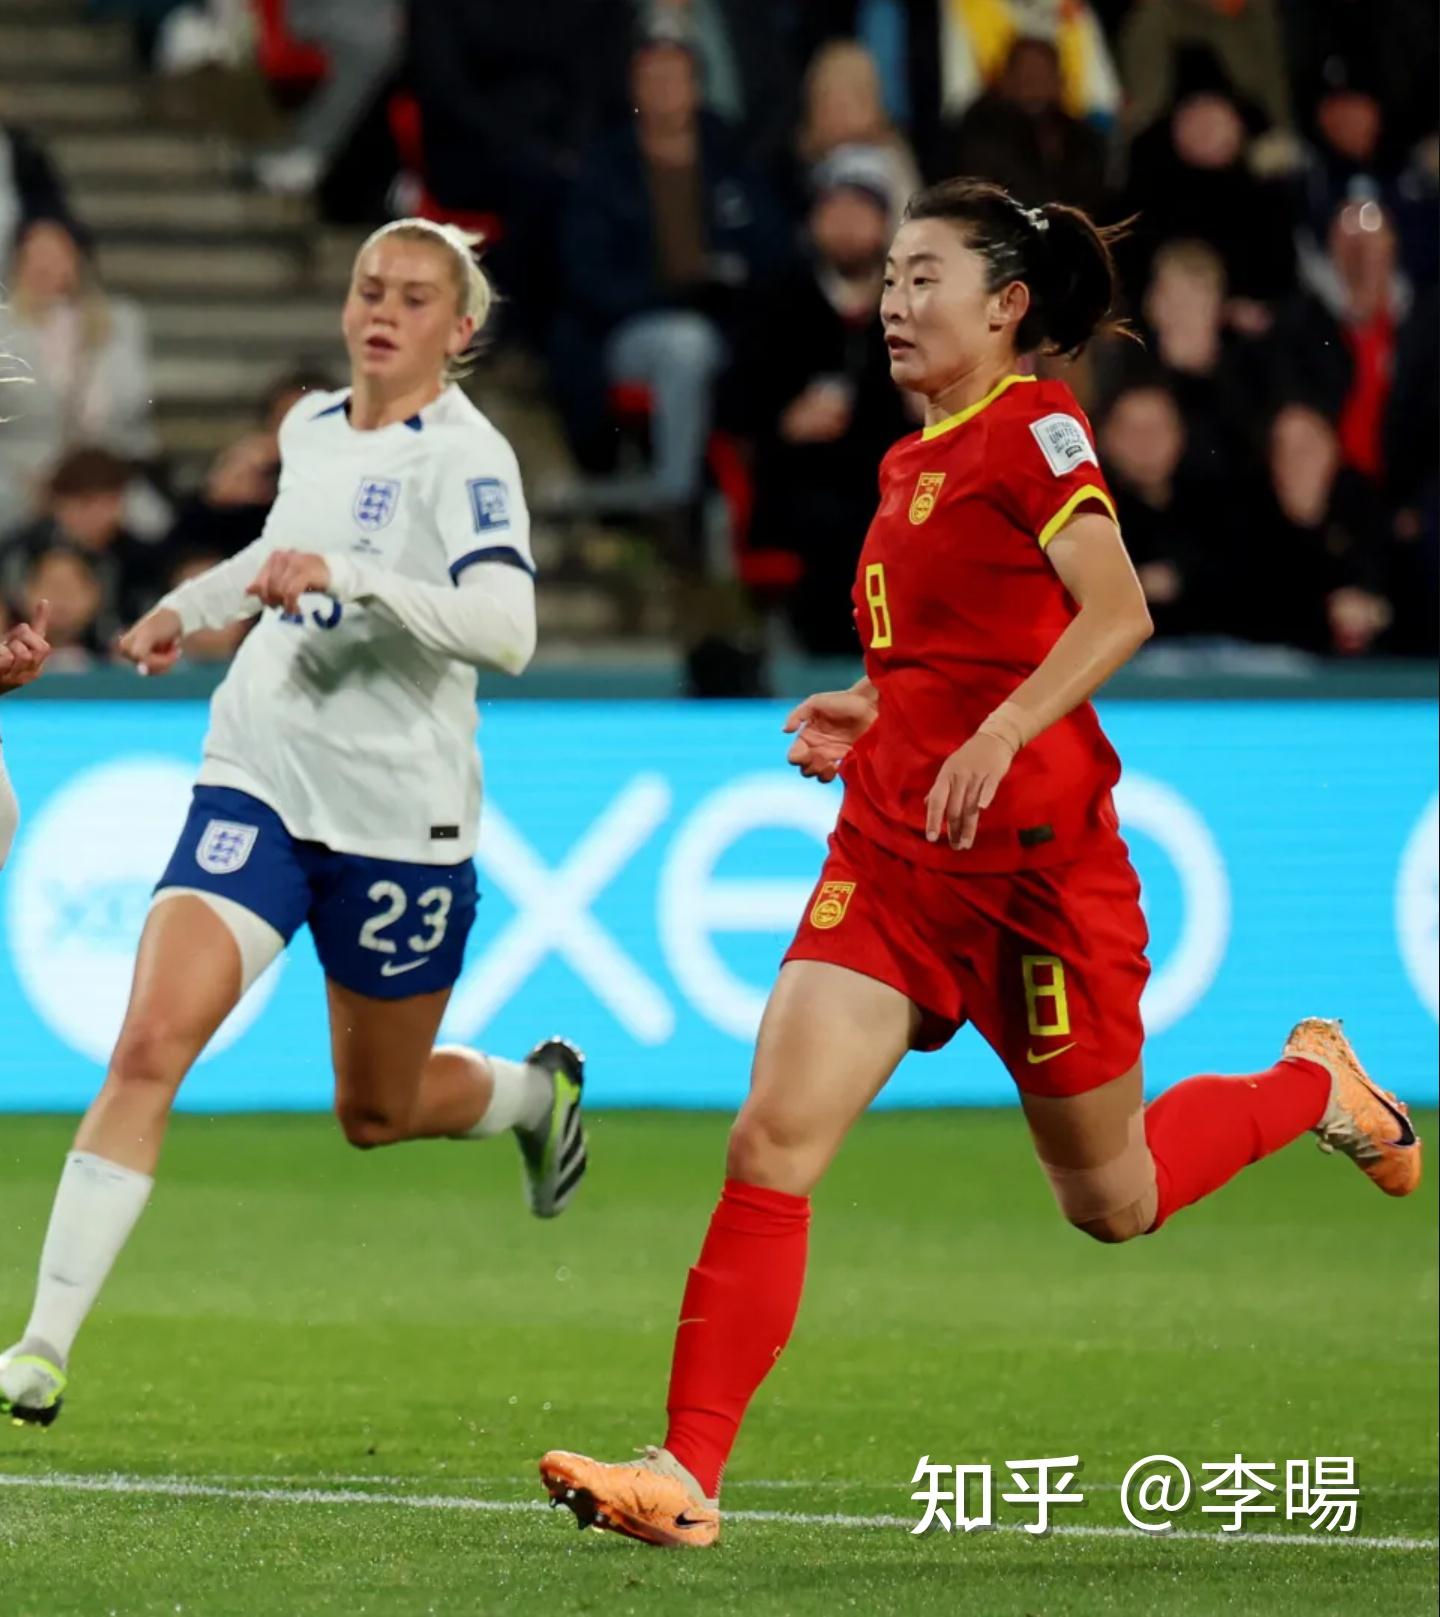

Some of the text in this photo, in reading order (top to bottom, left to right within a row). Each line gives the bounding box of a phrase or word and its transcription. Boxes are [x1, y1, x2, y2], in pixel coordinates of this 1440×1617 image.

[865, 562, 892, 648] 8
[359, 880, 453, 954] 23
[1022, 955, 1071, 1036] 8
